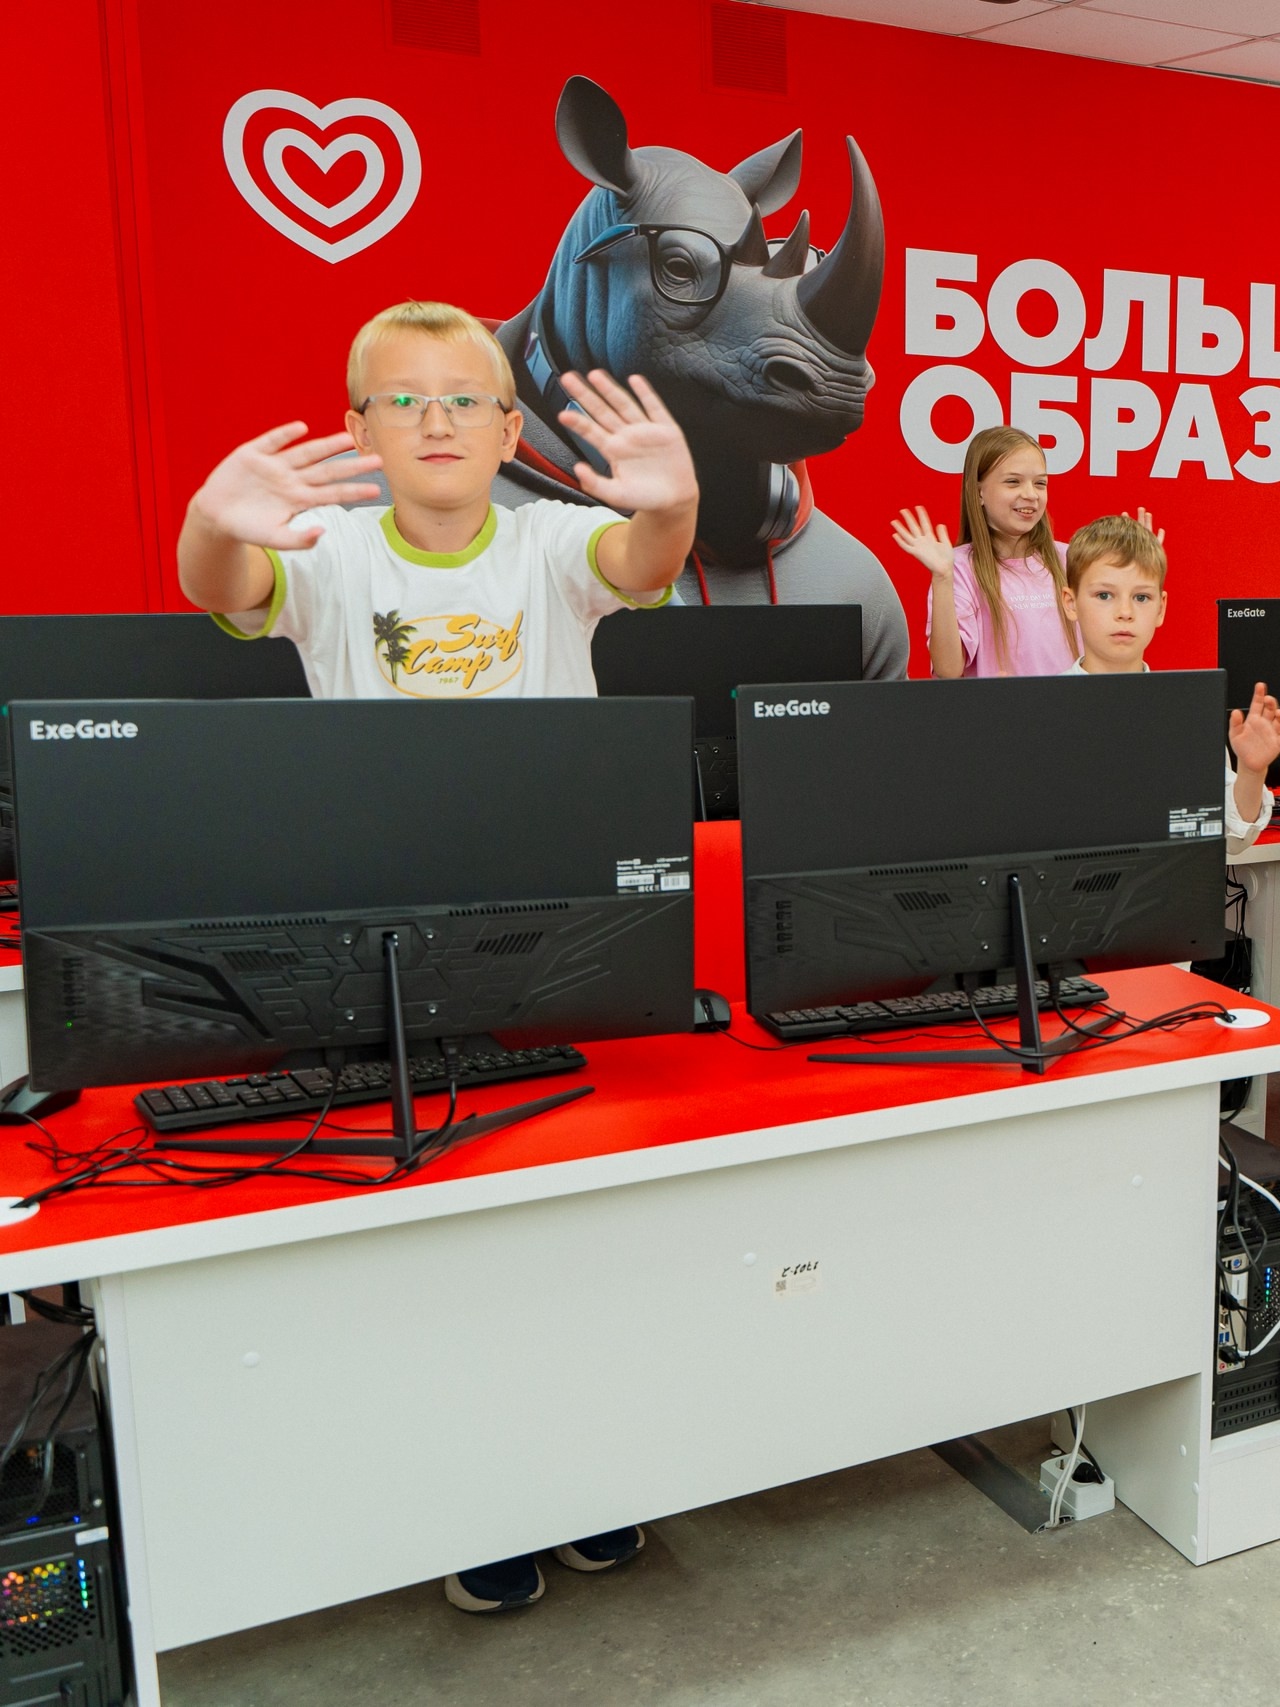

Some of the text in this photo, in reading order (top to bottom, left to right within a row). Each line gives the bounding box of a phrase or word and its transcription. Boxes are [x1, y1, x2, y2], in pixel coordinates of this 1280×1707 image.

[1227, 608, 1266, 618] ExeGate
[439, 609, 524, 662] Surf
[404, 639, 494, 690] Camp
[754, 699, 831, 718] ExeGate
[29, 719, 139, 741] ExeGate
